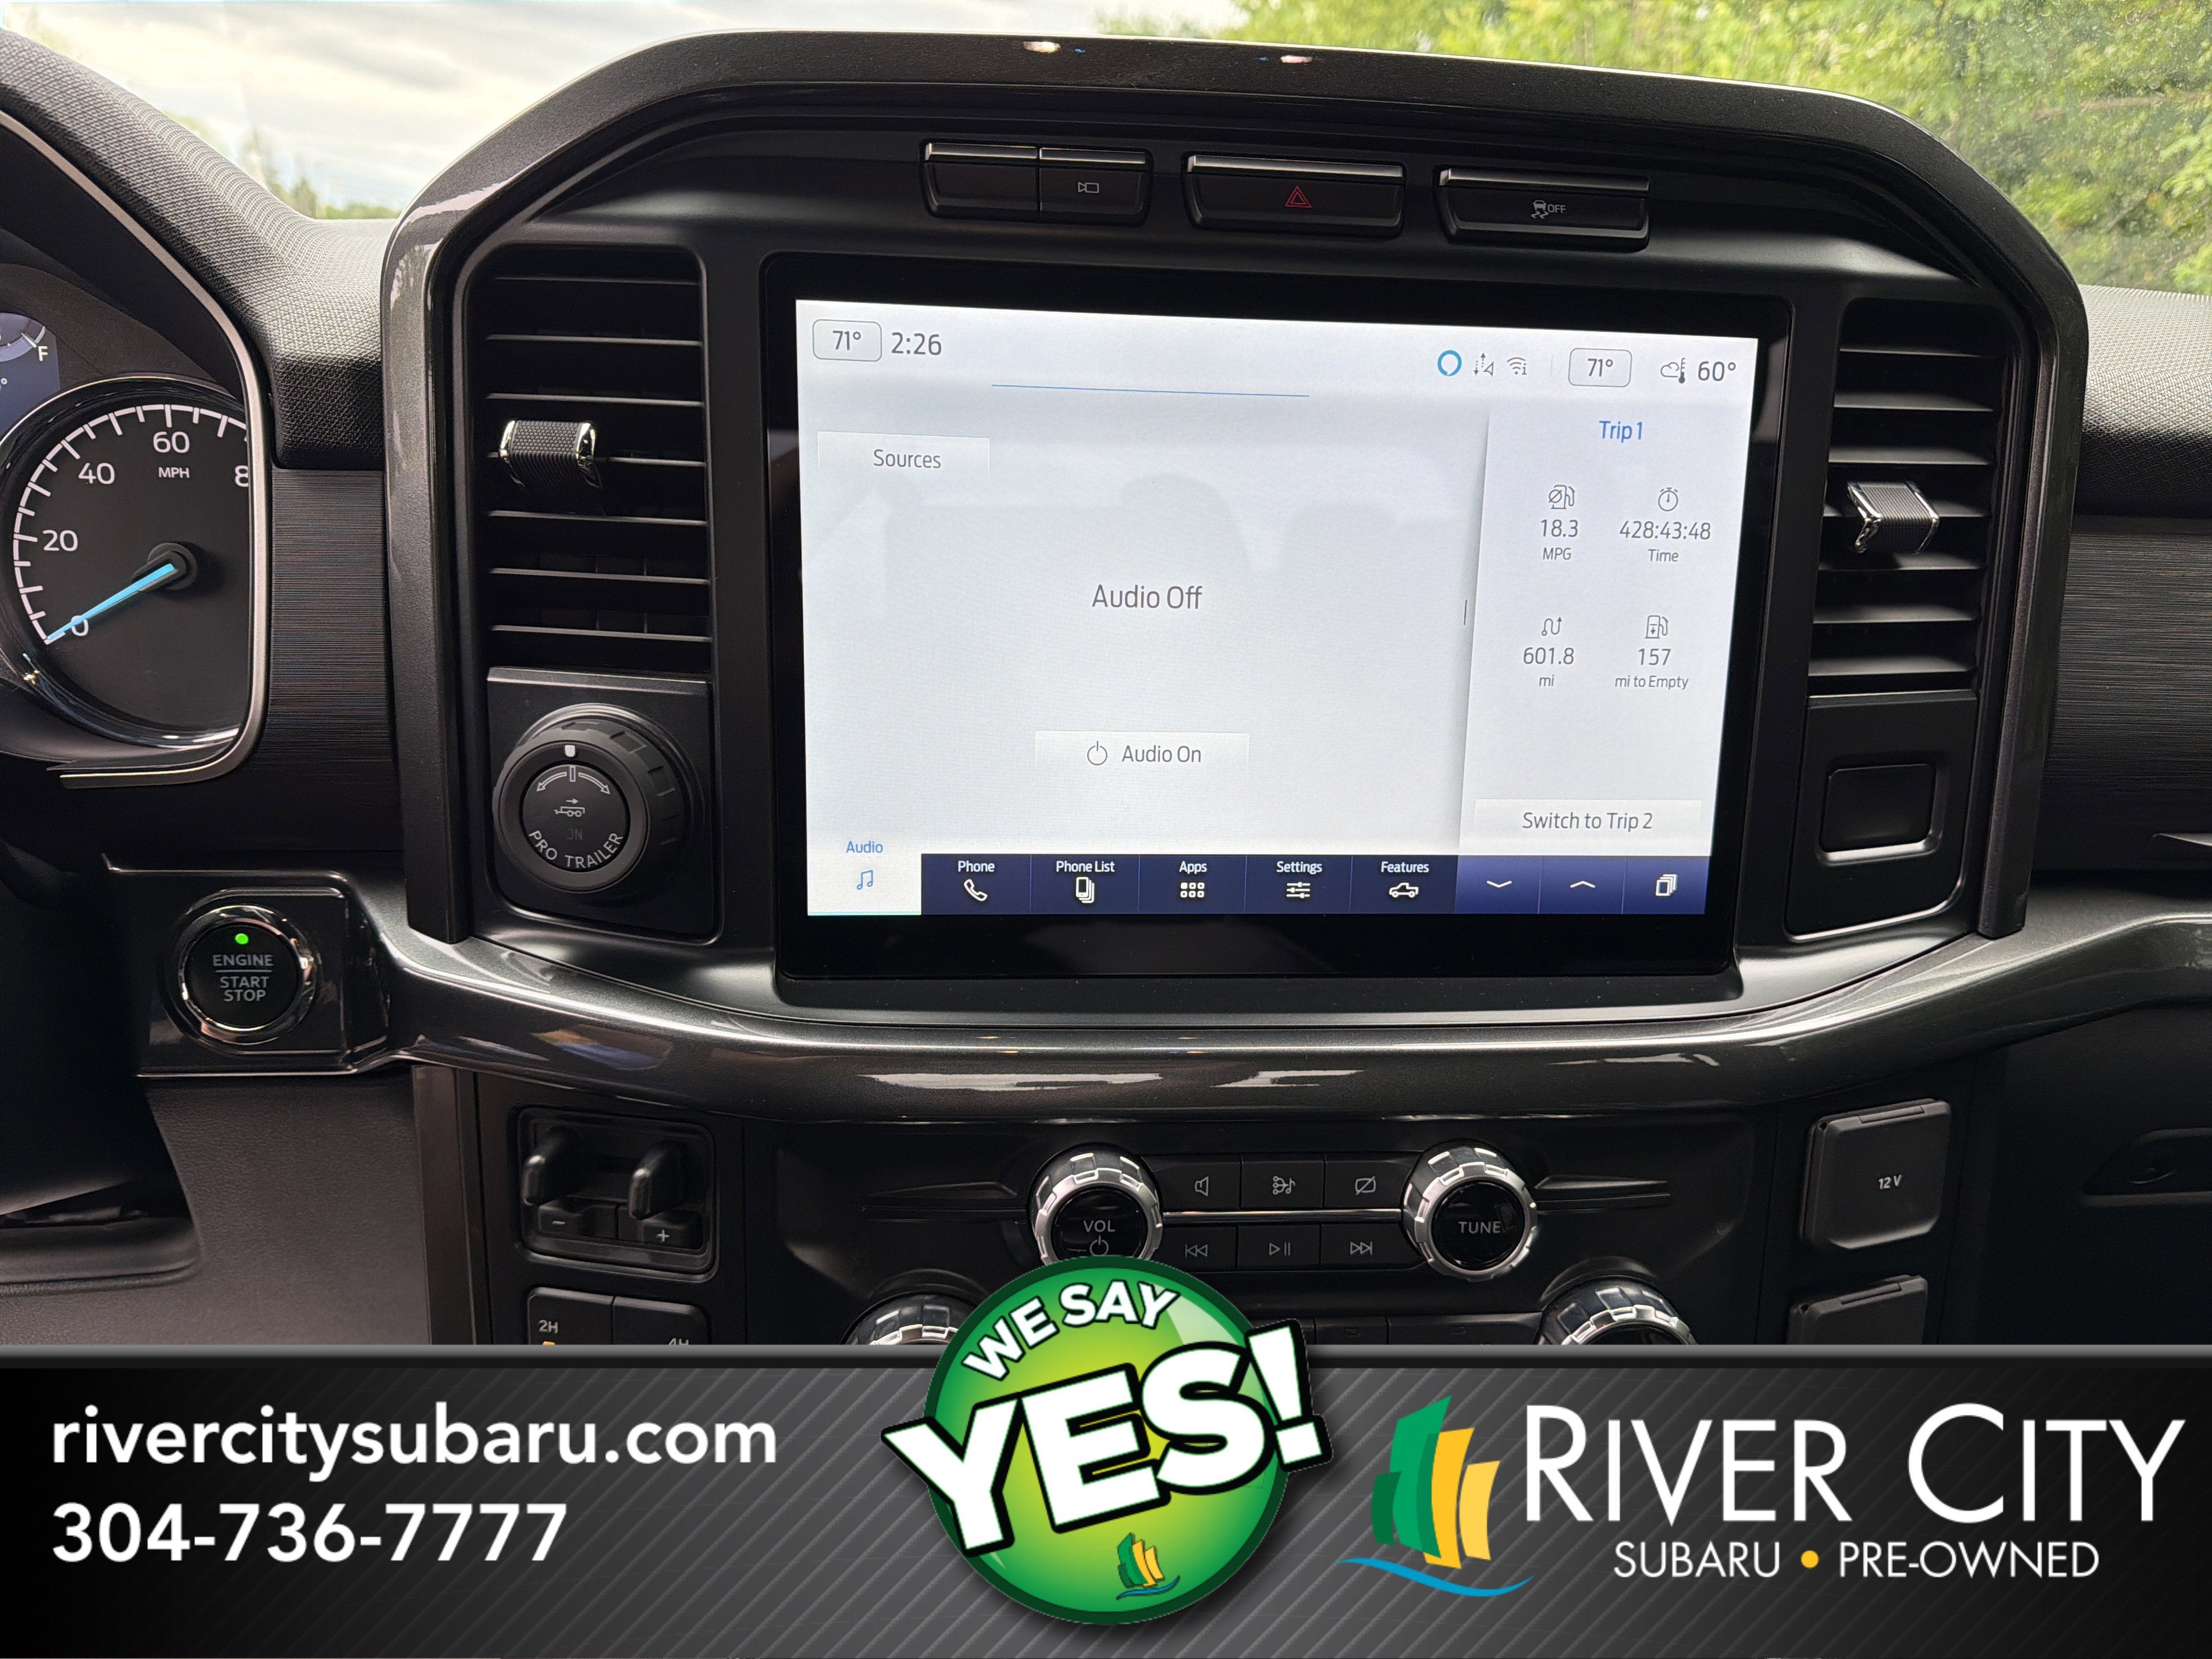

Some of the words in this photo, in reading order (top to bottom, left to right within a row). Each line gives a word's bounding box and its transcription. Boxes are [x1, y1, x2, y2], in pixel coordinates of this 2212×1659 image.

[1547, 204, 1566, 213] OFF
[891, 332, 942, 356] 2:26
[38, 346, 49, 362] F
[1599, 420, 1633, 443] Trip
[1637, 421, 1643, 440] 1
[153, 431, 190, 453] 60
[873, 449, 941, 469] Sources
[78, 462, 115, 484] 40
[159, 467, 190, 478] MPH
[1541, 519, 1578, 538] 18.3
[1619, 520, 1711, 540] 428:43:48
[42, 529, 78, 551] 20
[1543, 547, 1572, 560] MPG
[1647, 549, 1679, 562] Time
[1092, 584, 1160, 608] Audio
[1167, 585, 1203, 610] Off
[70, 615, 89, 636] 0
[1523, 647, 1574, 665] 601.8
[1638, 648, 1671, 665] 157
[1539, 674, 1555, 687] mi
[1615, 675, 1630, 687] mi
[1633, 675, 1646, 687] to
[1648, 675, 1689, 690] Empty
[1121, 744, 1172, 763] Audio
[1177, 746, 1201, 763] On
[1522, 811, 1579, 829] Switch
[1584, 812, 1602, 829] to
[1606, 812, 1639, 832] Trip
[1642, 812, 1652, 829] 2
[528, 830, 557, 860] PRO
[564, 833, 623, 869] TRAILER
[846, 840, 883, 854] Audio
[958, 860, 995, 872] Phone
[1056, 860, 1093, 872] Phone
[1094, 860, 1115, 872] List
[1179, 860, 1207, 874] Apps
[1276, 861, 1323, 875] Settings
[1381, 861, 1429, 873] Features
[213, 954, 273, 967] ENGINE
[219, 976, 269, 989] START
[224, 989, 266, 1002] STOP
[1083, 1220, 1115, 1232] VOL
[1458, 1221, 1501, 1234] TUNE
[539, 1319, 558, 1334] 2H
